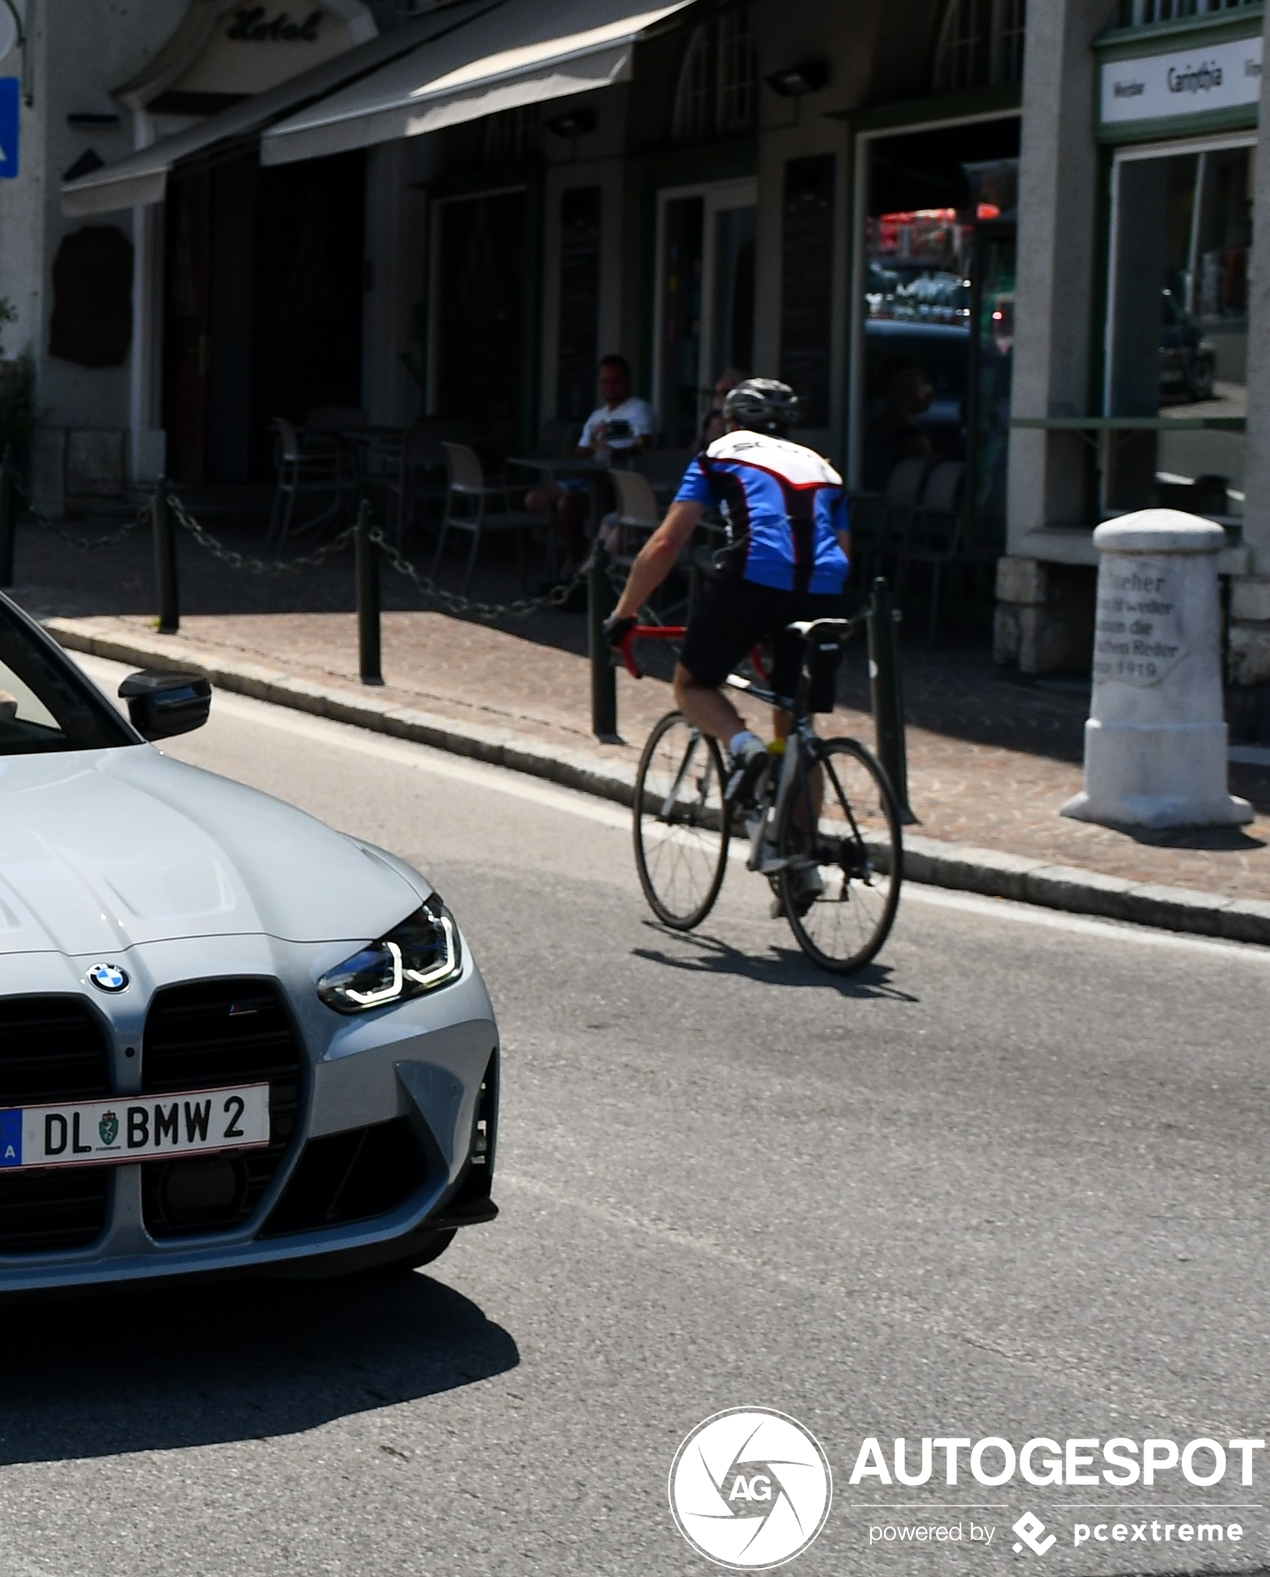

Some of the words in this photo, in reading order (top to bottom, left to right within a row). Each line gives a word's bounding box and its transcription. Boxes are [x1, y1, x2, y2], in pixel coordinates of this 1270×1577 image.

[228, 6, 322, 41] Hotel
[1167, 60, 1223, 94] Carinthia
[44, 1112, 92, 1156] DL
[127, 1099, 212, 1149] BMW
[223, 1096, 245, 1138] 2
[4, 1145, 16, 1158] A
